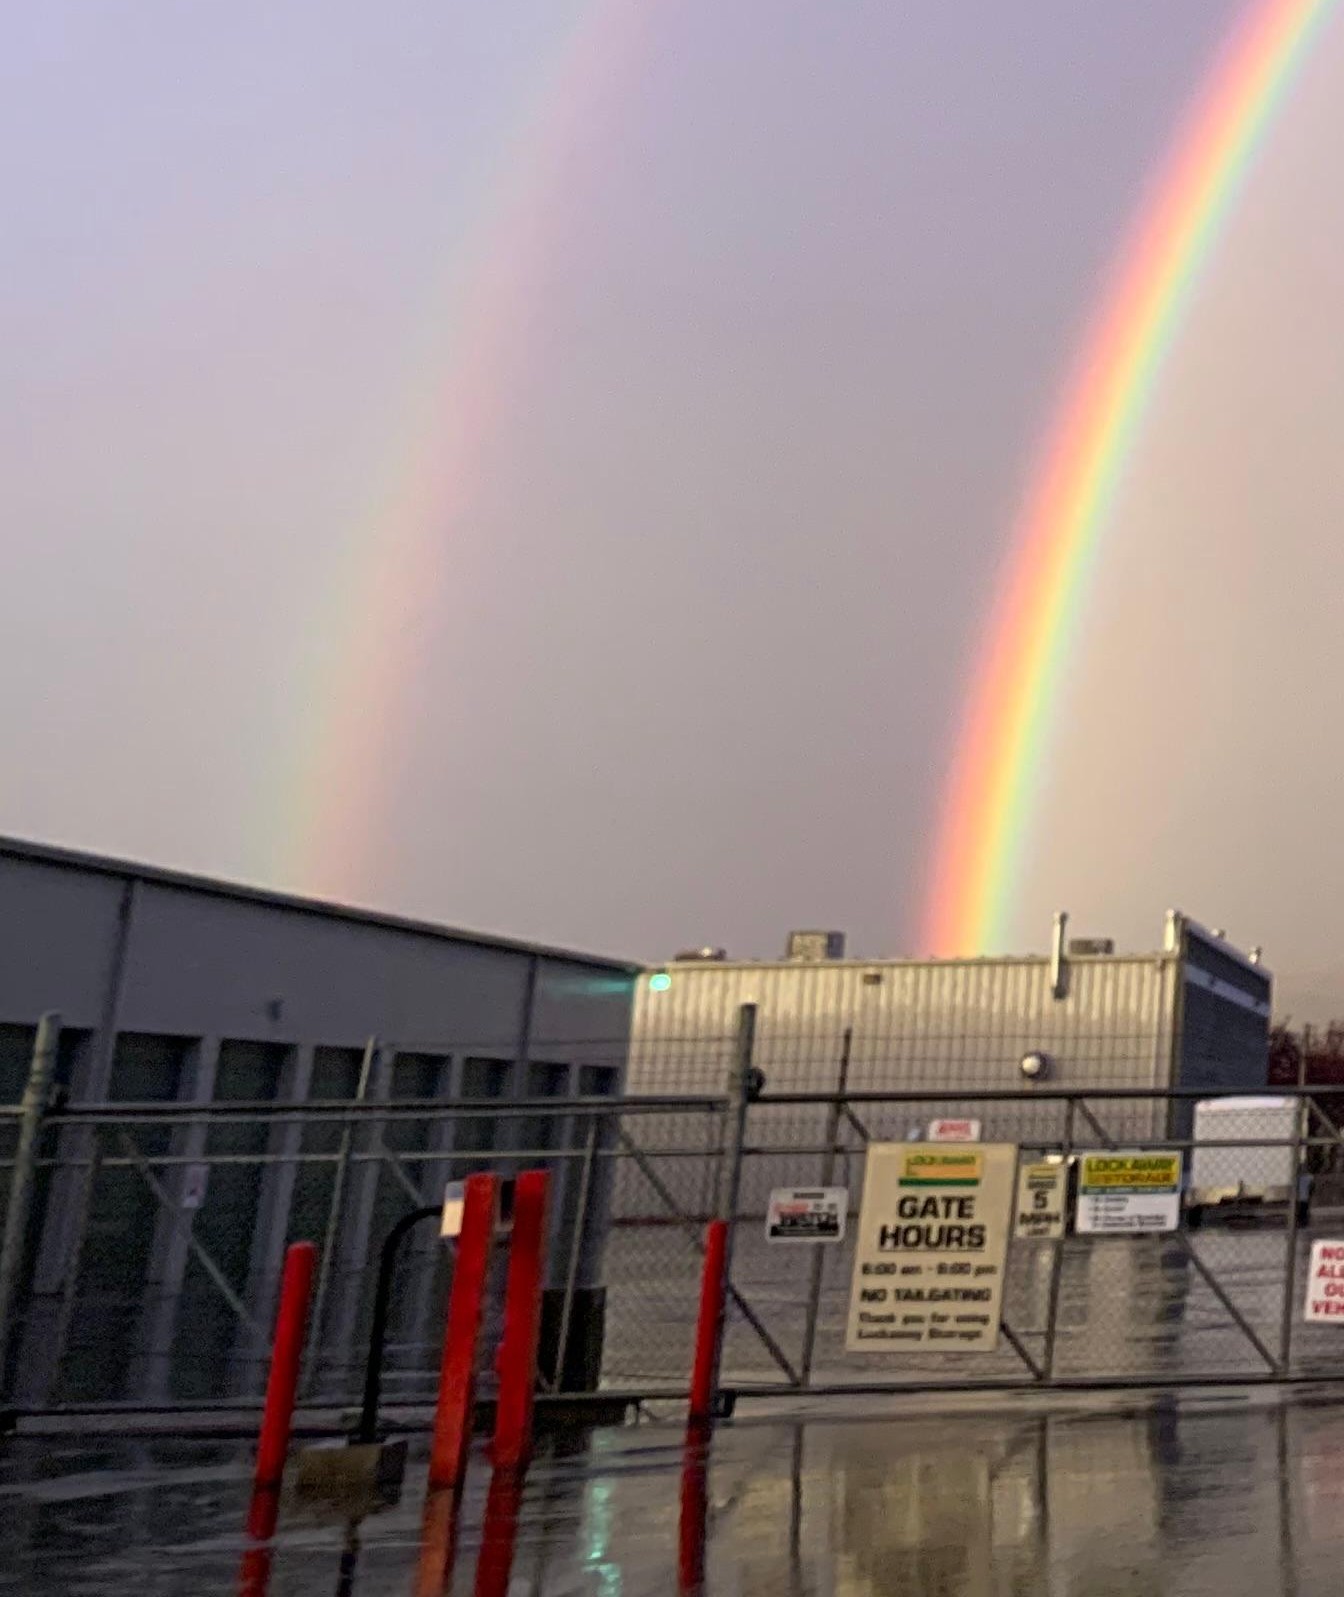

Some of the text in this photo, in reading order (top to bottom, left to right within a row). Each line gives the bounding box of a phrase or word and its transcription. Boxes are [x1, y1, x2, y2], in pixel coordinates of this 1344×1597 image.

[897, 1195, 975, 1219] GATE
[1033, 1190, 1049, 1209] 5
[879, 1224, 986, 1248] HOURS
[861, 1288, 992, 1302] NO TAILGATING
